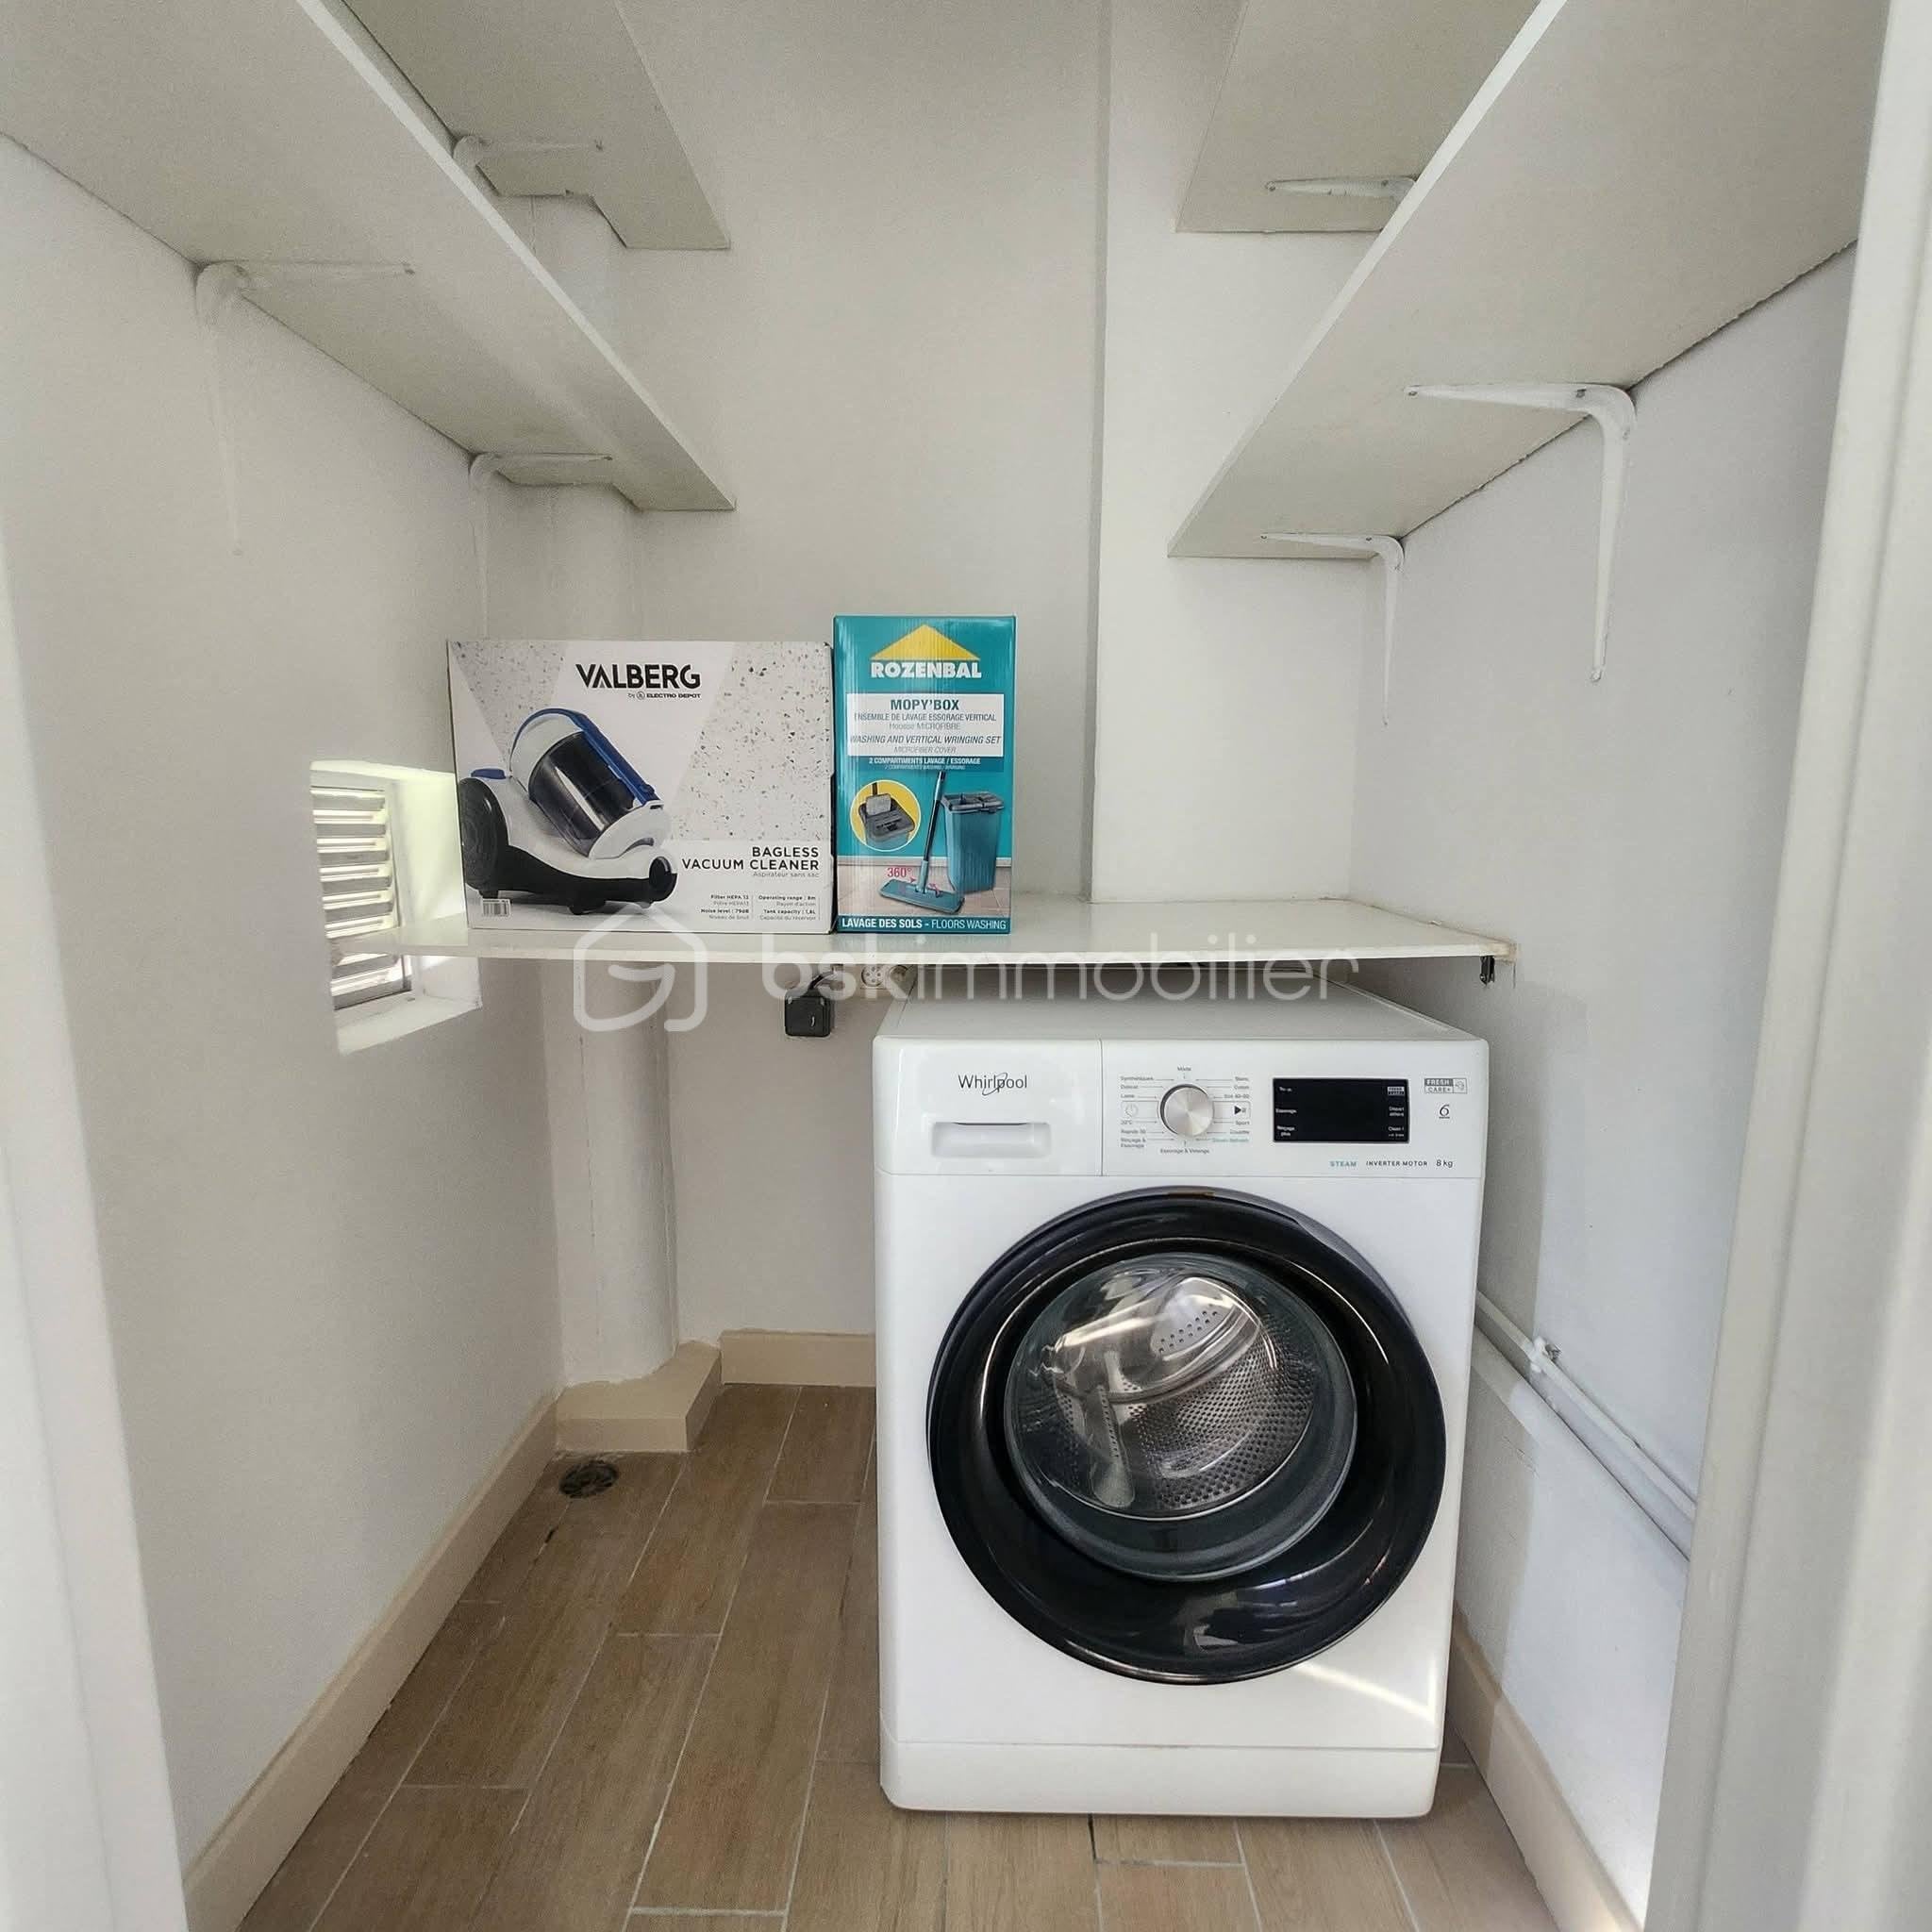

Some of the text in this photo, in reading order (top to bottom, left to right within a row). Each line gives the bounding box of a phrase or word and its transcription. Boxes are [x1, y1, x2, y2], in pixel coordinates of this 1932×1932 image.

[871, 662, 982, 678] ROZENBAL
[575, 664, 702, 690] VALBERG
[891, 699, 959, 710] MOPY'BOX
[854, 713, 996, 722] ENSEMBLE DE LAVAGE ESSORAGE VERTICAL
[850, 736, 1002, 744] WASHING AND VERTICAL WRINGING SET
[752, 847, 819, 858] BAGLESS
[681, 858, 819, 871] VACUUM CLEANER
[887, 867, 912, 878] 360°
[841, 918, 877, 928] LAVAGE
[878, 918, 897, 928] DES
[898, 918, 923, 928] SOLS
[931, 919, 965, 929] FLOORS
[966, 919, 1007, 929] WASHING
[958, 1073, 1027, 1096] Whirlpool
[1442, 1159, 1454, 1169] kg
